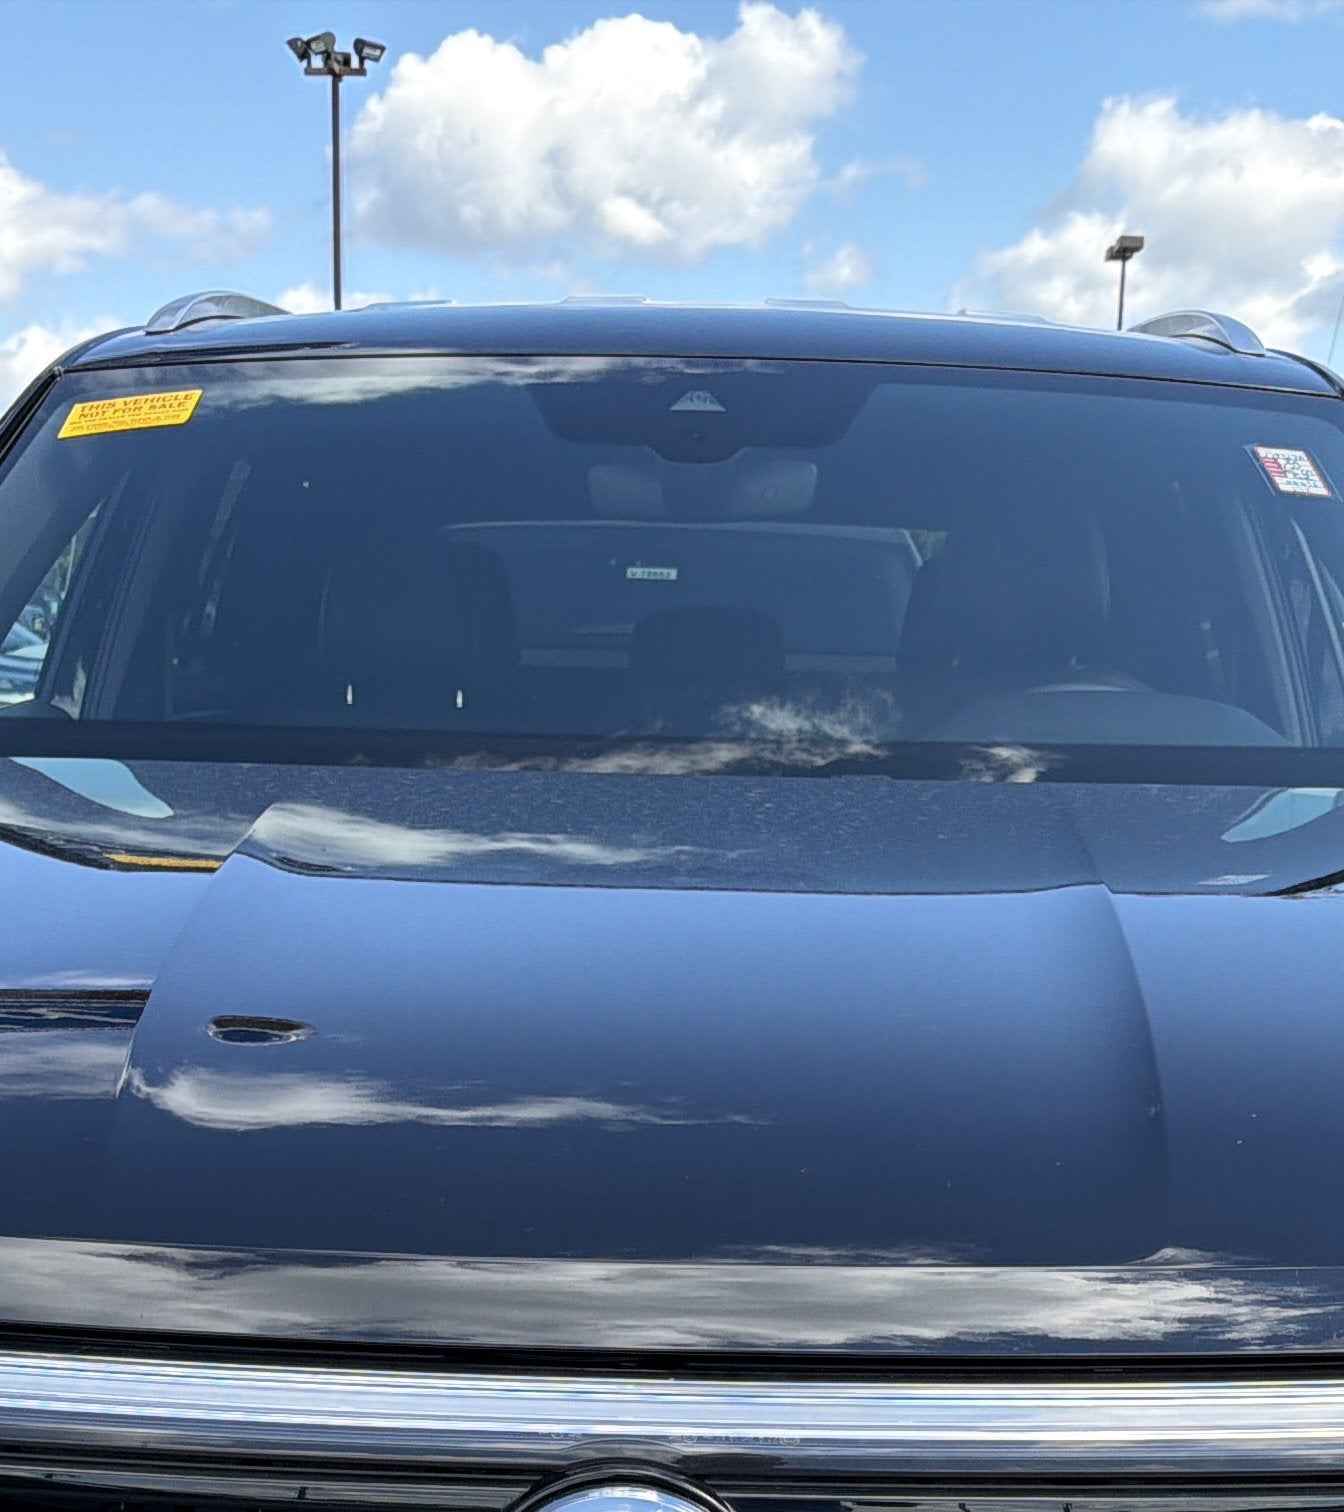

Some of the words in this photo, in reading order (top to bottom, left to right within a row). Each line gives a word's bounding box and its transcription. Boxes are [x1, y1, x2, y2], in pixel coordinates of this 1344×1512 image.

[79, 410, 108, 420] NOT
[112, 406, 142, 416] FOR
[147, 401, 187, 410] SALE
[80, 401, 116, 413] THIS
[122, 393, 193, 407] VEHICLE
